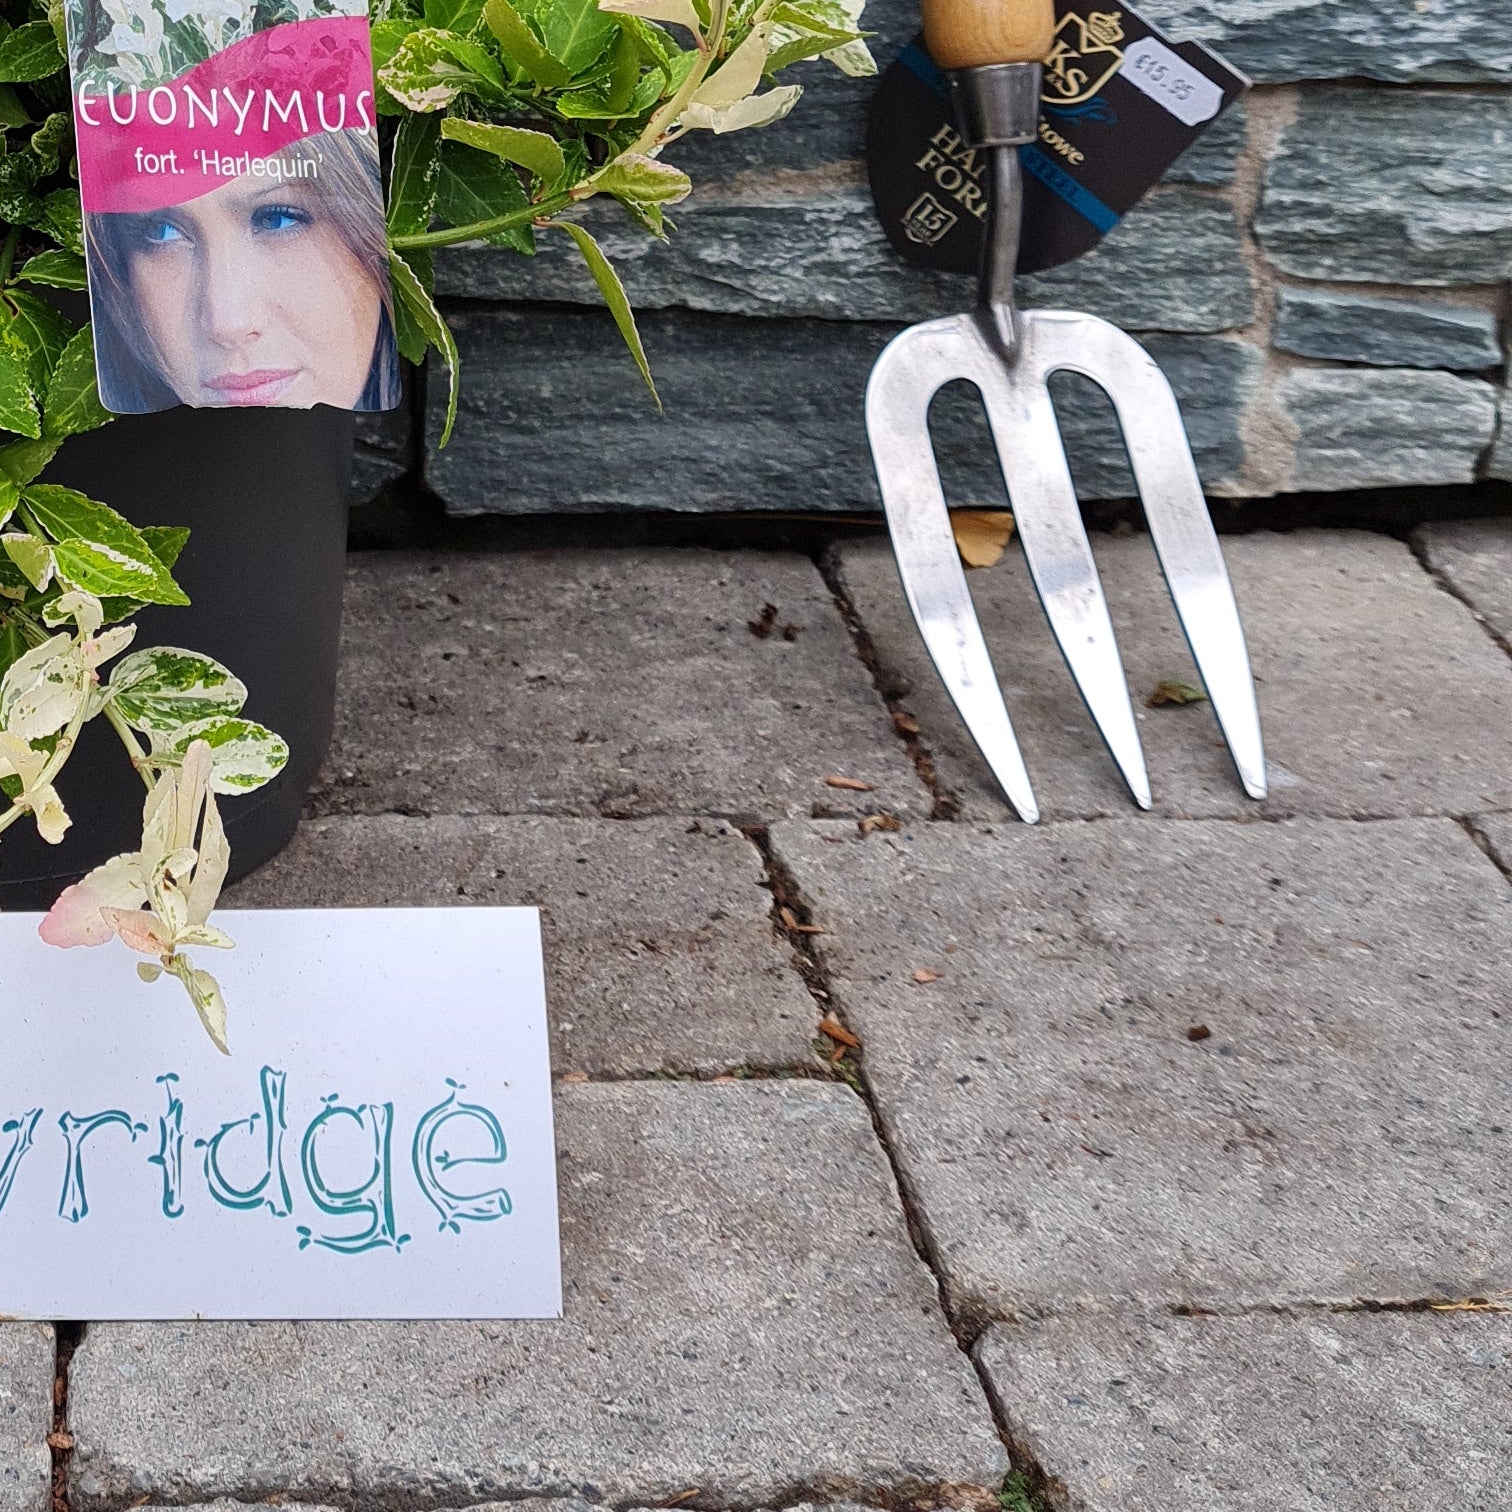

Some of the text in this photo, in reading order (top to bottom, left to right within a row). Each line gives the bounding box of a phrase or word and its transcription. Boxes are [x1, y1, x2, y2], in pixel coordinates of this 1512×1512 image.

[78, 79, 372, 137] EUONYMUS
[134, 147, 185, 175] fort.
[930, 123, 987, 180] HA
[1039, 115, 1085, 166] towe
[914, 147, 989, 220] FOR
